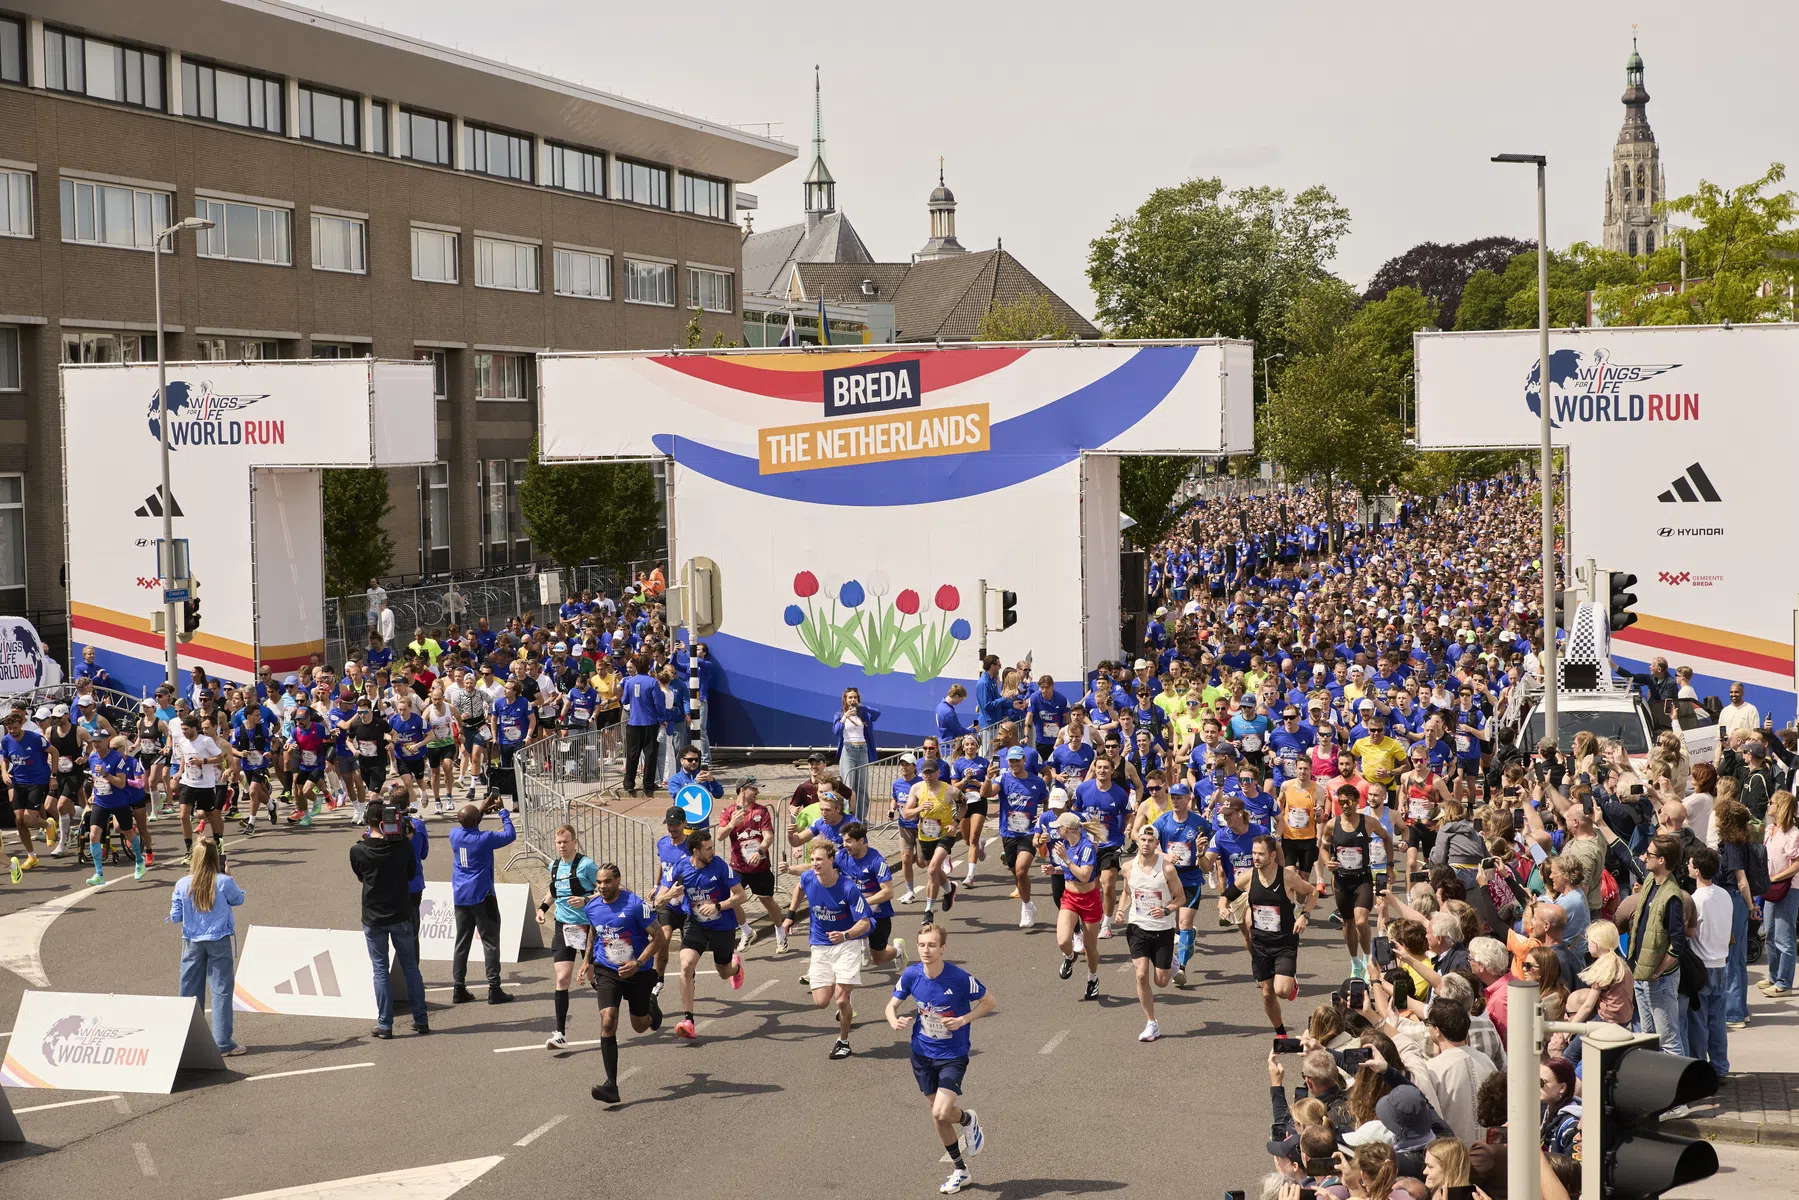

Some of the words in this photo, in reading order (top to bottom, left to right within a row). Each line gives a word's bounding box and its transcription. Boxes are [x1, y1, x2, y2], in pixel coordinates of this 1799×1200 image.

[1579, 366, 1641, 381] WINGS
[833, 369, 912, 407] BREDA
[1587, 381, 1623, 394] LIFE
[190, 395, 238, 409] WINGS
[1554, 394, 1644, 422] WORLD
[1648, 393, 1699, 421] RUN
[196, 409, 224, 420] LIFE
[171, 421, 241, 446] WORLD
[244, 420, 285, 445] RUN
[767, 432, 811, 465] THE
[817, 413, 981, 460] NETHERLANDS
[1677, 528, 1724, 536] HYUNDAI
[0, 664, 19, 681] ORLD
[19, 663, 35, 679] RUN
[433, 909, 455, 917] WIN
[420, 924, 455, 939] WORL
[80, 1028, 119, 1037] WINGS
[81, 1037, 105, 1045] LIFE
[58, 1045, 114, 1064] WORLD
[114, 1048, 149, 1066] RUN
